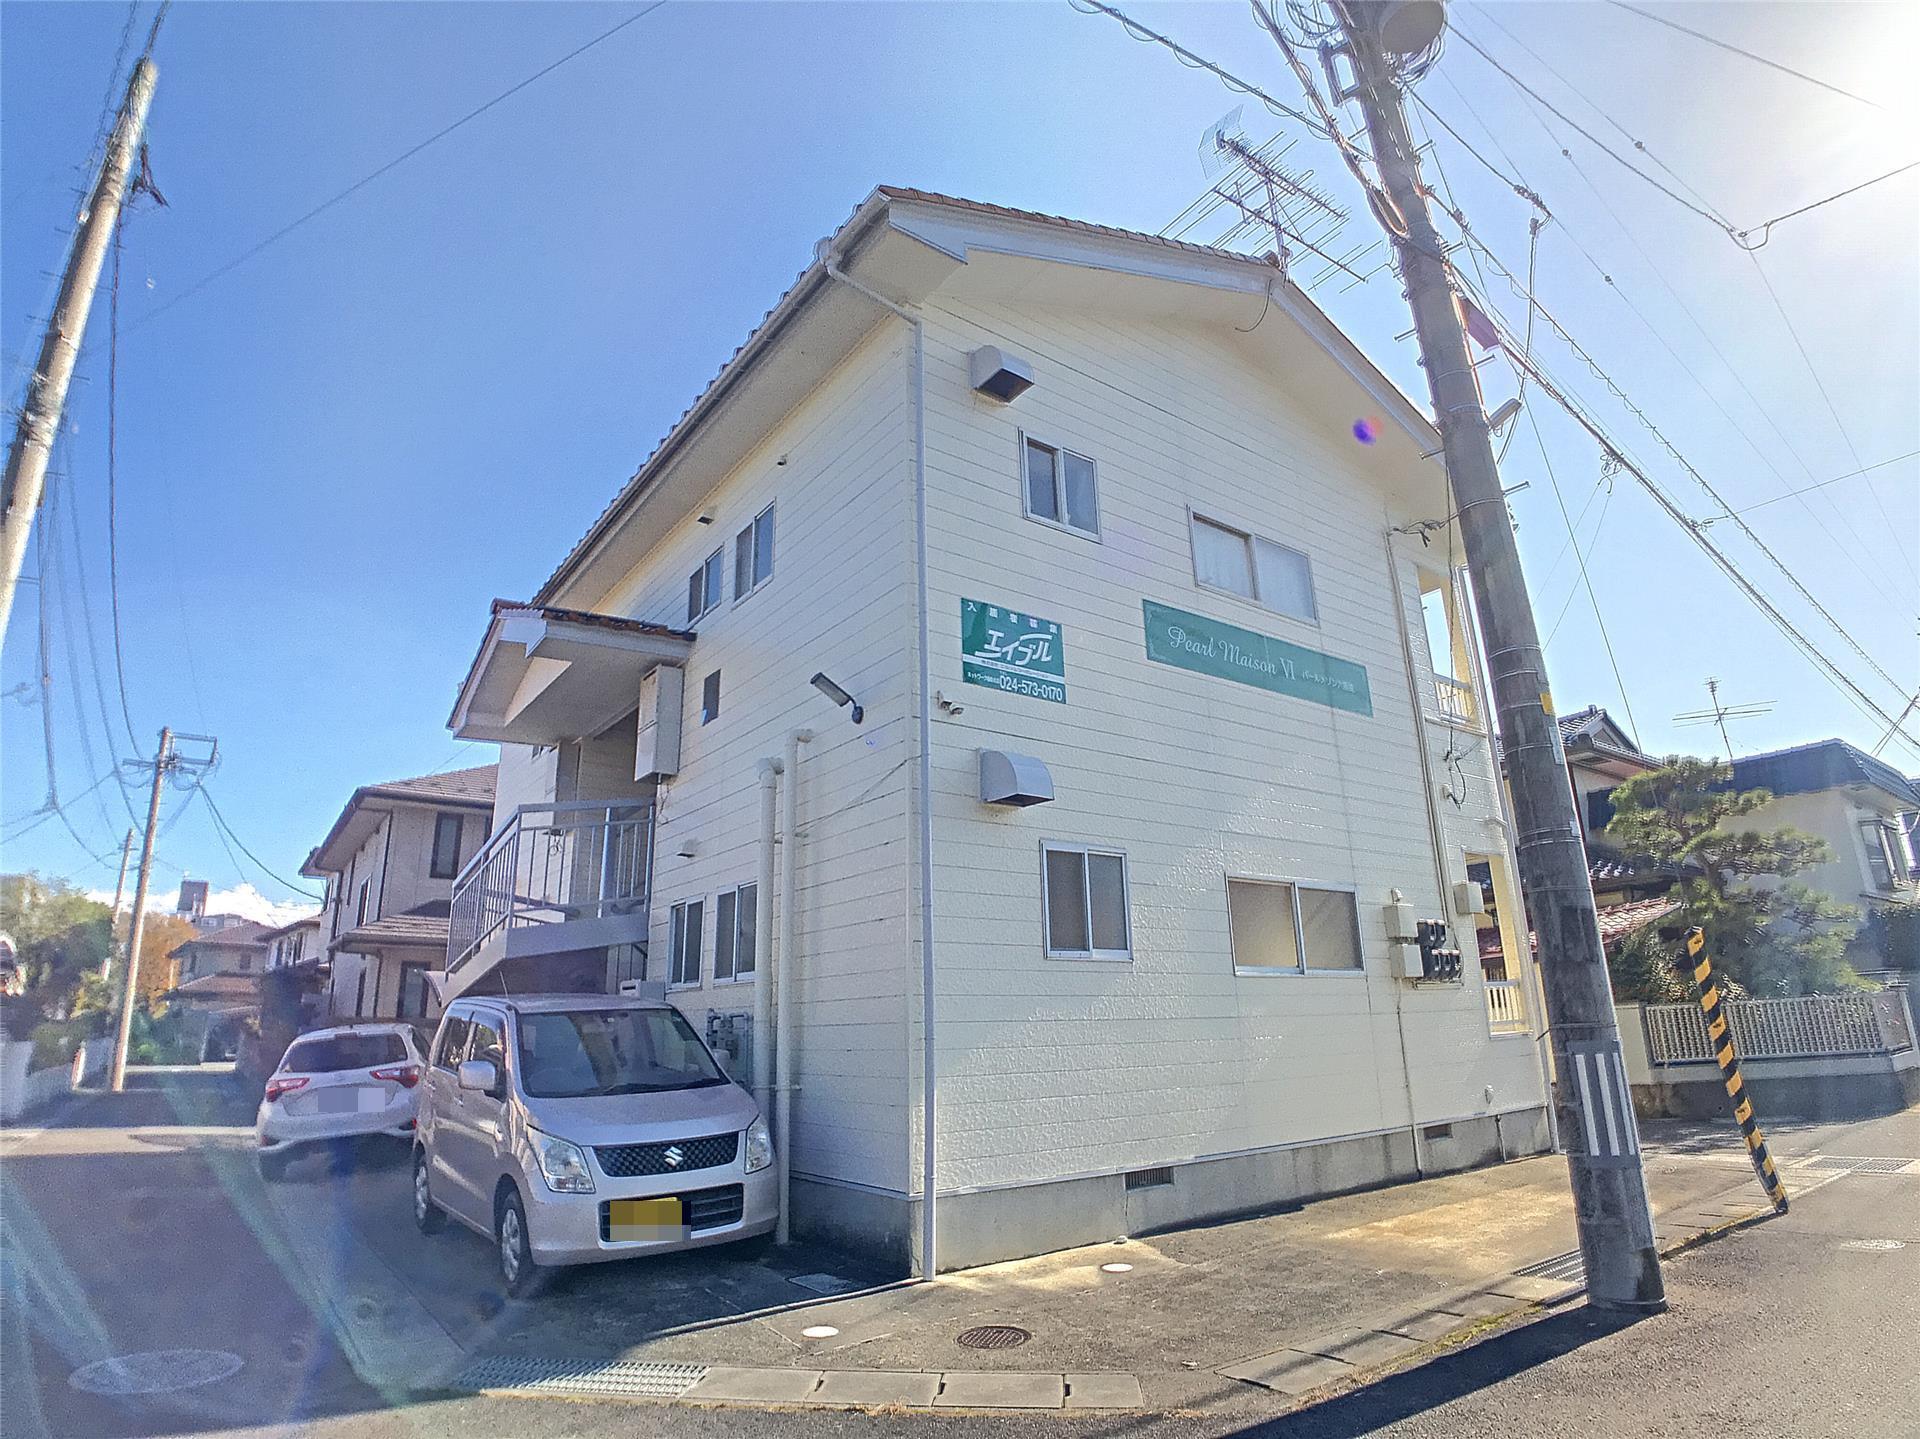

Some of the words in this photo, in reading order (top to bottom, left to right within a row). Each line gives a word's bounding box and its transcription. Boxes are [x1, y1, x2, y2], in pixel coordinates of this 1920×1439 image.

[975, 629, 1053, 666] エイブル
[1167, 626, 1217, 658] Pearl
[1218, 639, 1277, 675] Maison
[999, 675, 1064, 702] 024-573-0170
